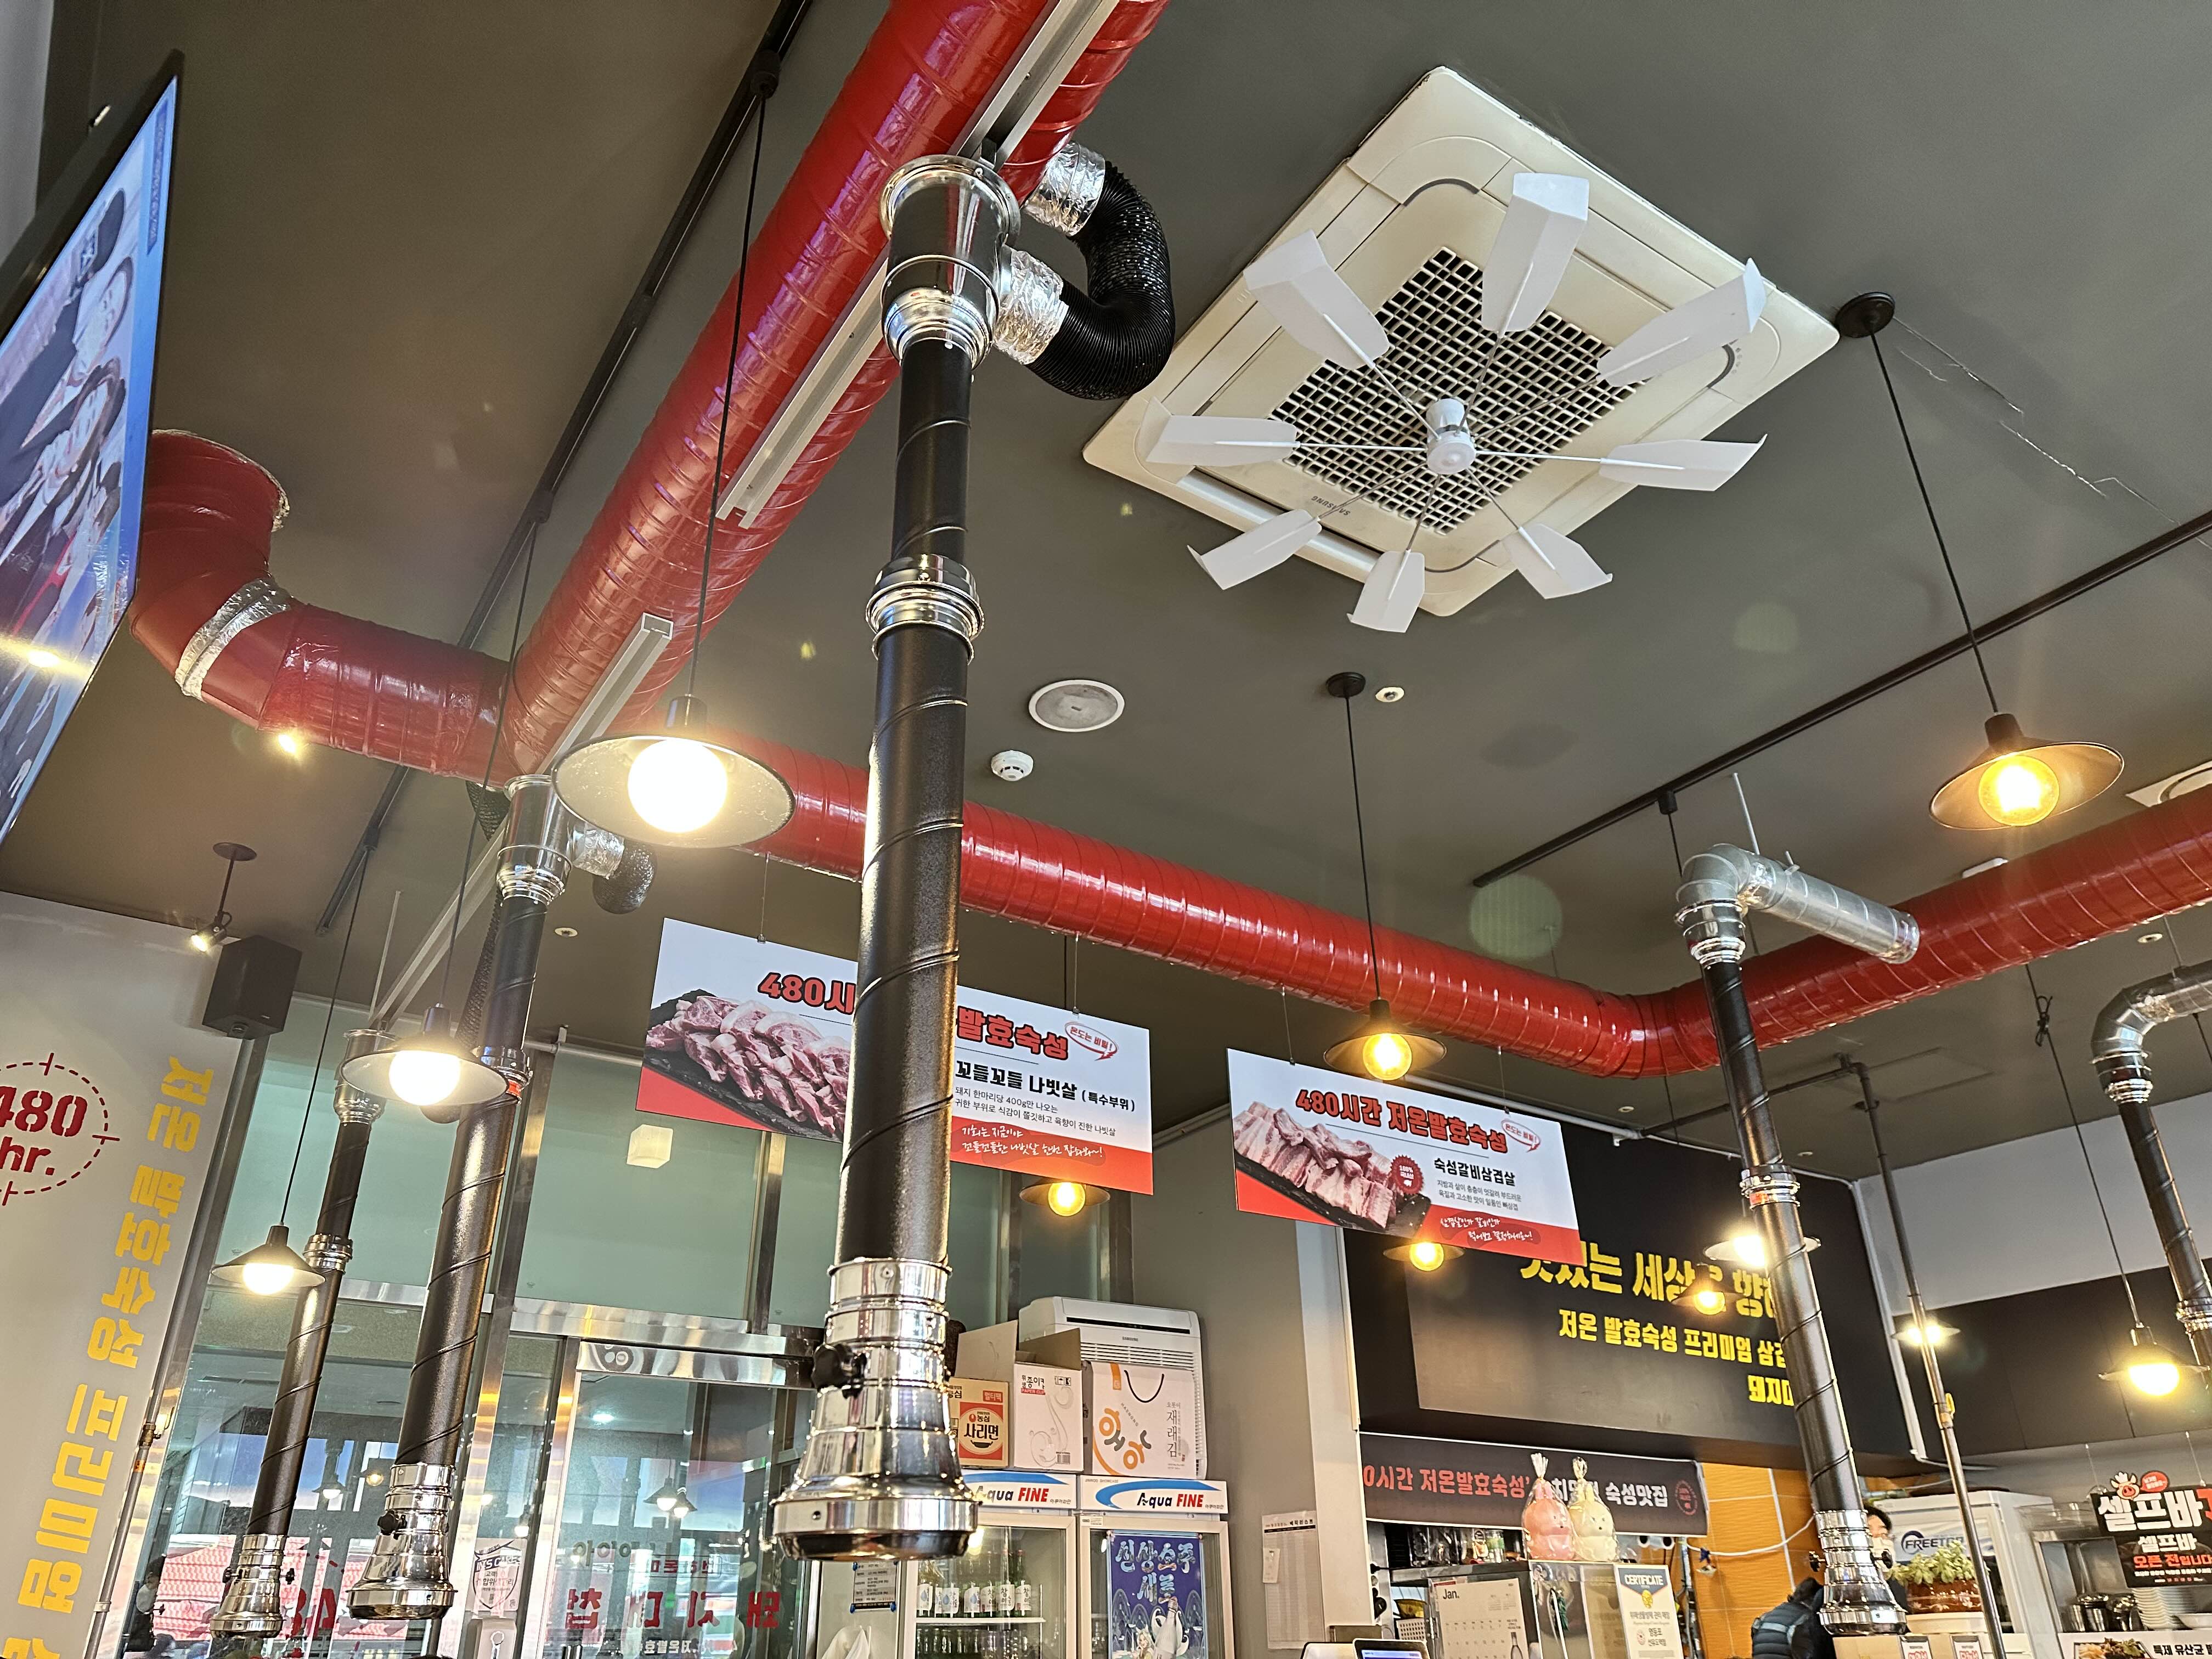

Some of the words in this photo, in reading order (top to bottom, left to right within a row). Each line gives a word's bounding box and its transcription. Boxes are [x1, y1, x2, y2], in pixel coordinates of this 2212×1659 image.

[956, 1006, 1069, 1060] 발효숙성
[1070, 1026, 1092, 1042] 온도는
[1093, 1036, 1113, 1052] 비밀!
[955, 1060, 1023, 1090] 꼬들꼬들
[1029, 1075, 1077, 1101] 나빗살
[0, 1086, 88, 1137] 480
[146, 1053, 216, 1154] 저온
[955, 1087, 971, 1097] 돼지
[973, 1090, 1003, 1103] 한마리당
[1006, 1097, 1034, 1109] 400g만
[1036, 1102, 1058, 1114] 나오는
[955, 1098, 970, 1109] 귀한
[973, 1101, 996, 1113] 부위로
[998, 1106, 1021, 1119] 식감이
[1023, 1111, 1053, 1124] 쫄깃하고
[1054, 1117, 1076, 1129] 육향이
[1078, 1121, 1093, 1132] 진한
[1094, 1125, 1116, 1137] 나빗살
[1295, 1088, 1383, 1127] 480시간
[1386, 1100, 1509, 1154] 저온발효숙성
[962, 1125, 991, 1137] 기회는
[991, 1125, 1024, 1138] 지금이야
[0, 1136, 55, 1176] hr.
[962, 1141, 1008, 1154] 꼬들꼬들한
[1010, 1142, 1040, 1155] 나빗살
[1042, 1144, 1063, 1156] 한번
[1434, 1158, 1516, 1187] 숙성갈비삼겹살
[1437, 1180, 1453, 1189] 지방과
[1455, 1183, 1466, 1191] 살이
[1467, 1185, 1483, 1195] 층층이
[1500, 1191, 1522, 1202] 부드러운
[1438, 1189, 1455, 1199] 육질과
[1456, 1193, 1472, 1203] 고소한
[1473, 1196, 1485, 1205] 맛이
[1486, 1198, 1502, 1208] 일품인
[1440, 1216, 1474, 1228] 삼겹살인가
[1474, 1217, 1500, 1228] 갈비인가
[87, 1162, 187, 1370] 발효숙성
[1559, 1308, 1598, 1342] 저온
[1604, 1316, 1679, 1353] 발효숙성
[1683, 1328, 1753, 1364] 프리미엄
[984, 1392, 1002, 1402] 멀티팩
[964, 1423, 998, 1440] 사리면
[1167, 1409, 1177, 1458] 재래김
[16, 1382, 129, 1615] 프리미엄
[1018, 1487, 1049, 1502] FINE
[1137, 1492, 1173, 1509] Aqua
[1176, 1493, 1204, 1508] FINE
[1604, 1481, 1668, 1508] 숙성맛집
[2098, 1489, 2204, 1532] 셀프바
[1115, 1539, 1197, 1574] 신상소주
[2137, 1533, 2198, 1553] 셀프바
[2134, 1555, 2163, 1568] 오픈
[1624, 1574, 1664, 1586] CERTIFICATE
[1443, 1589, 1460, 1600] Jan.
[2152, 1645, 2173, 1656] 특제
[2174, 1644, 2204, 1655] 유산균
